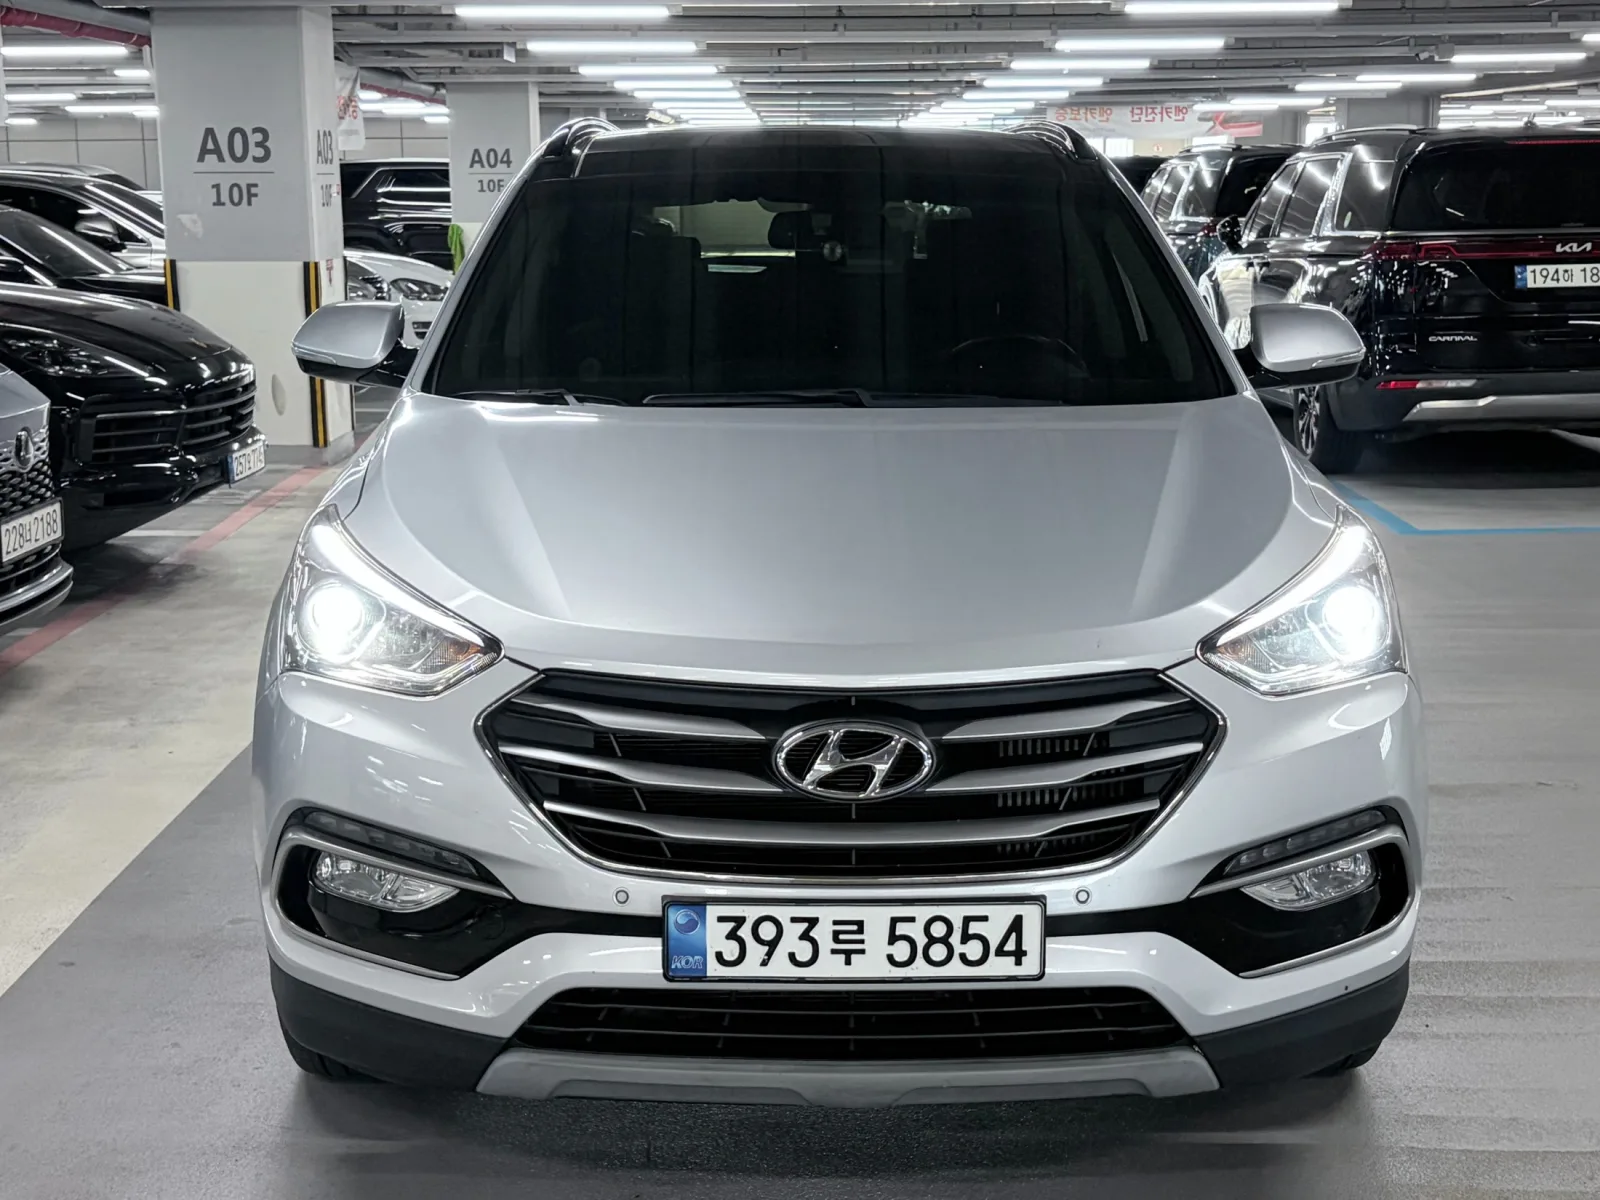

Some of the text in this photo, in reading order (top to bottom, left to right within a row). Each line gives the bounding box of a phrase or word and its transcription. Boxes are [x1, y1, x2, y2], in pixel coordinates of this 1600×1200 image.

[196, 126, 272, 163] A03
[317, 129, 334, 164] A03
[469, 148, 512, 168] A04
[211, 182, 259, 207] 10F
[478, 179, 504, 192] 10F
[1530, 267, 1574, 284] 194하
[714, 914, 1027, 967] 393루 5854
[671, 955, 704, 969] KOR
